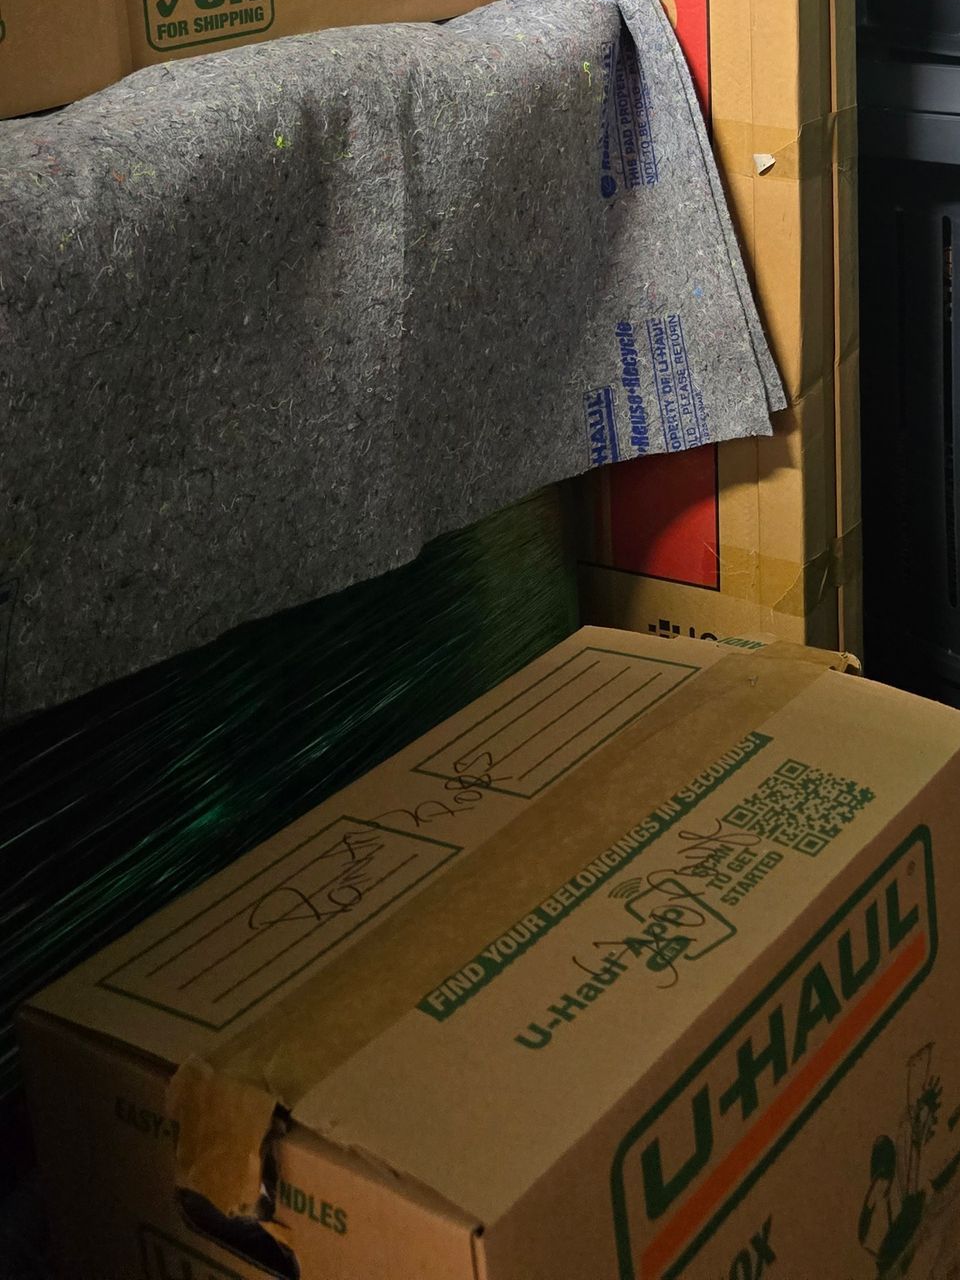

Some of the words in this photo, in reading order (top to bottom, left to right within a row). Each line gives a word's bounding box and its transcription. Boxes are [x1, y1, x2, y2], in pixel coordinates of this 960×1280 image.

[157, 21, 189, 40] FOR
[194, 7, 264, 33] SHIPPING
[667, 314, 685, 365] RETURN
[676, 368, 693, 416] PLEASE
[427, 961, 485, 1012] FIND
[487, 914, 547, 963] YOUR
[545, 818, 660, 917] BELONGINGS
[655, 797, 682, 821] IN
[679, 735, 761, 804] SECONDS!
[706, 872, 731, 890] TO
[726, 847, 758, 871] GET
[720, 851, 785, 906] STARTED
[641, 879, 920, 1220] U-HAUL
